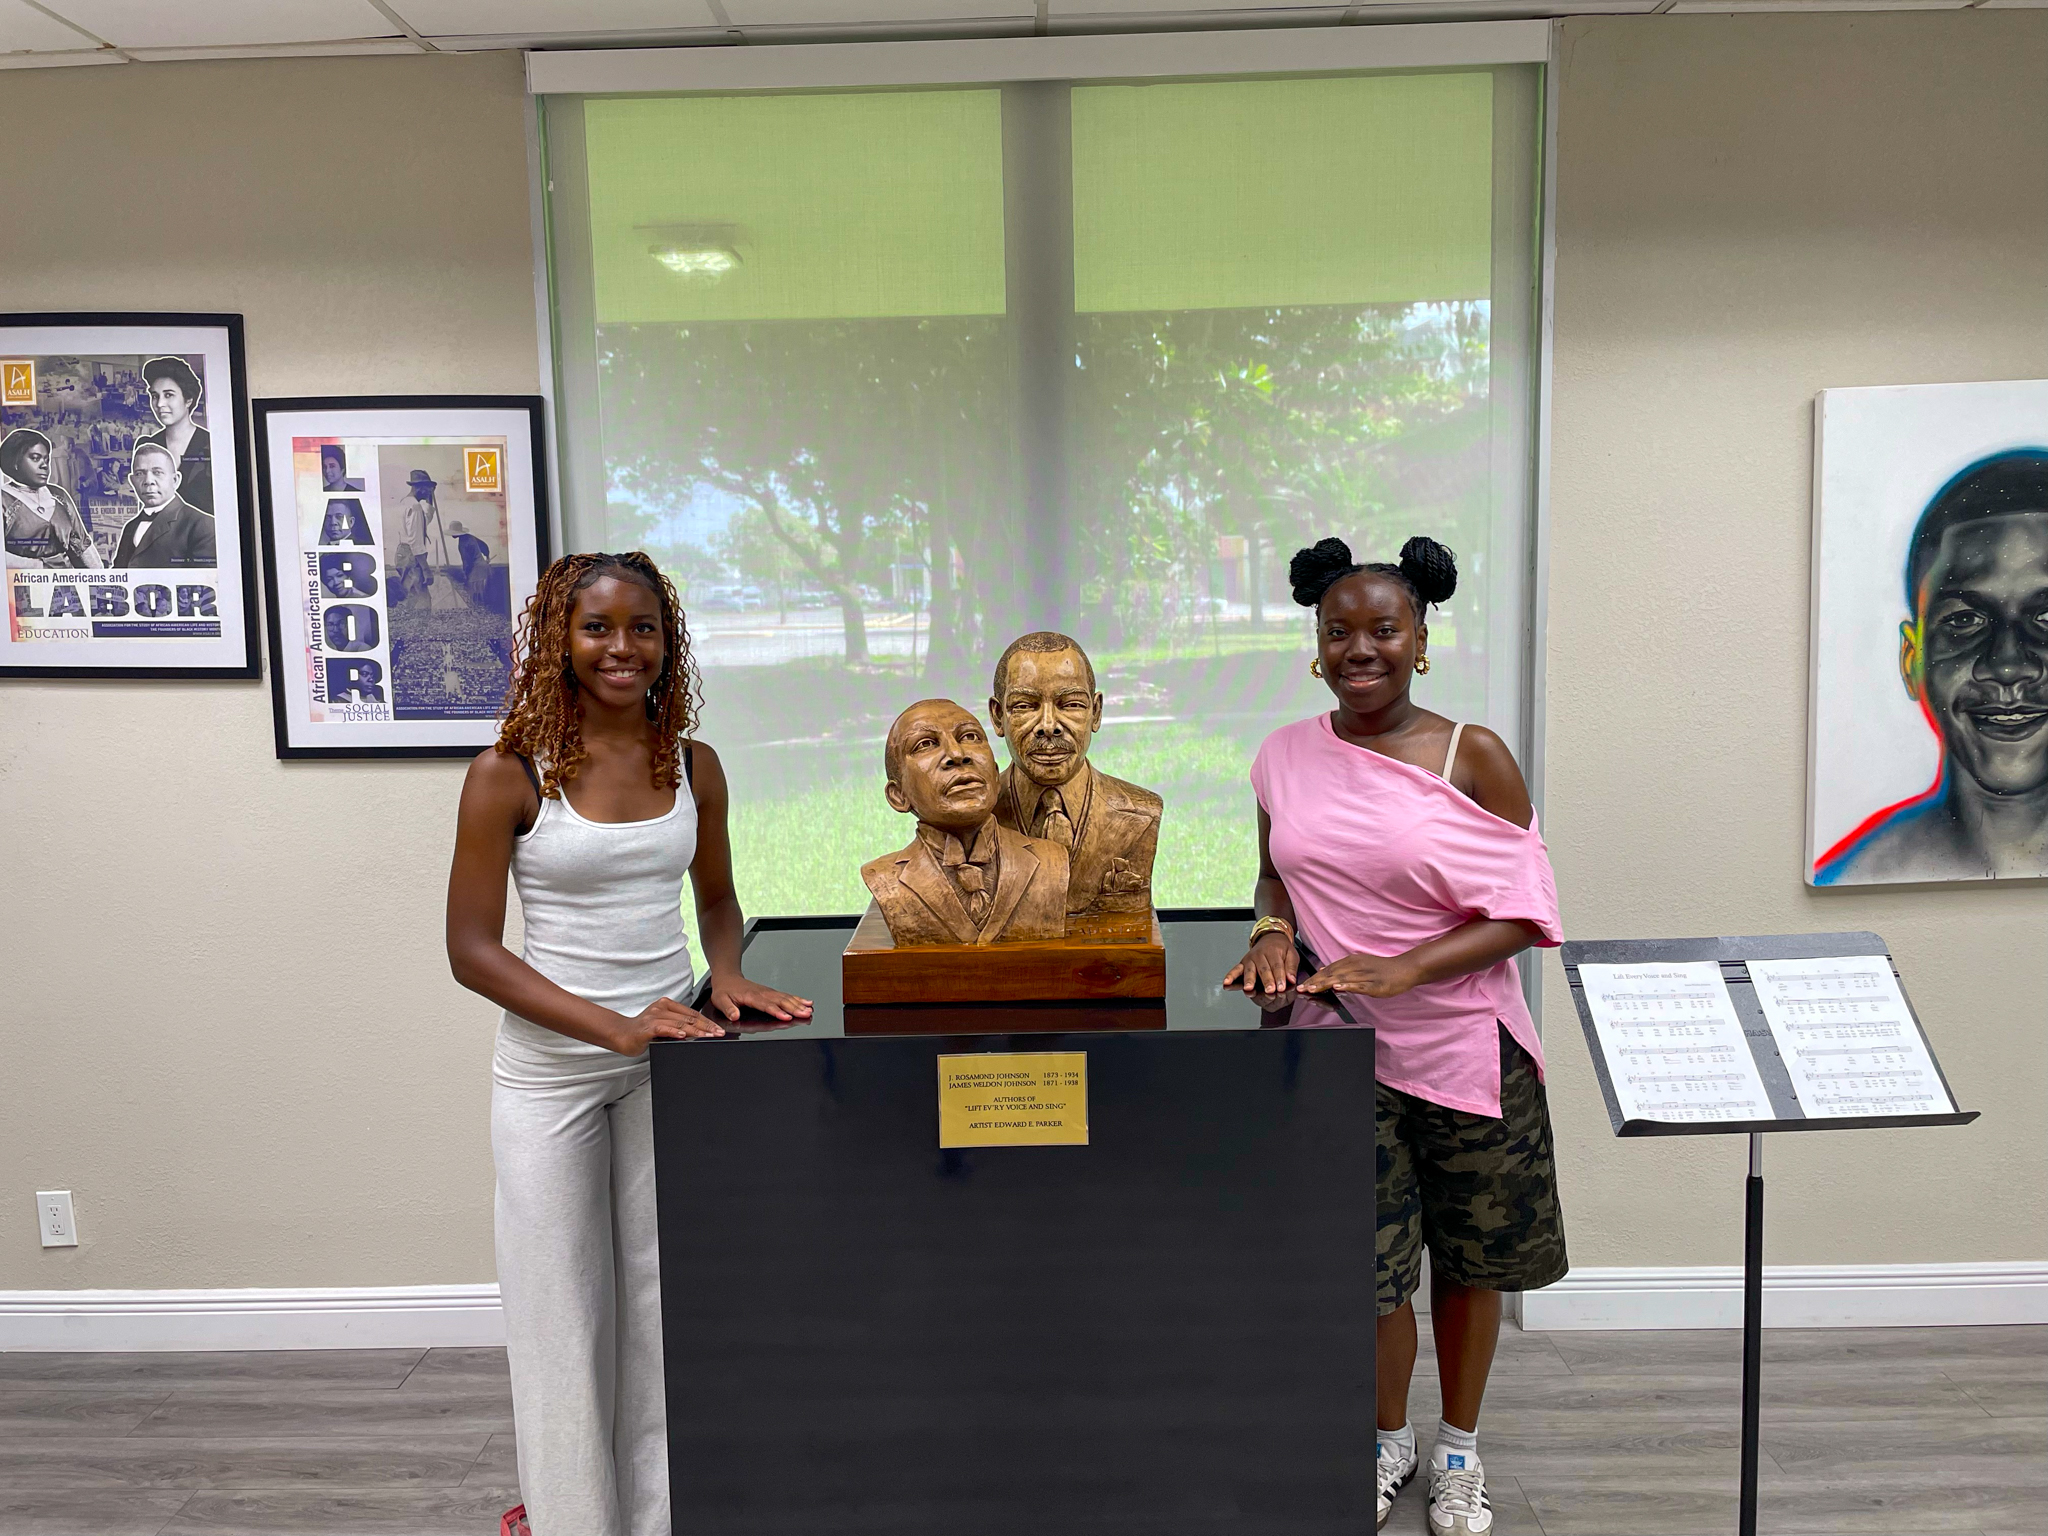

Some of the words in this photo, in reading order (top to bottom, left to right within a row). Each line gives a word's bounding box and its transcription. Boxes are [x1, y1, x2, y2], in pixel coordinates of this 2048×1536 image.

[304, 551, 317, 576] and
[13, 573, 49, 583] African
[52, 572, 107, 583] Americans
[109, 572, 129, 583] and
[318, 445, 387, 704] LABOR
[14, 584, 219, 618] LABOR
[307, 580, 323, 651] Americans
[18, 629, 89, 638] EDUCATION
[312, 655, 326, 704] African
[345, 704, 390, 713] SOCIAL
[342, 712, 390, 722] JUSTICE
[996, 1072, 1030, 1080] JOHNSON
[994, 1121, 1027, 1129] EDWARD
